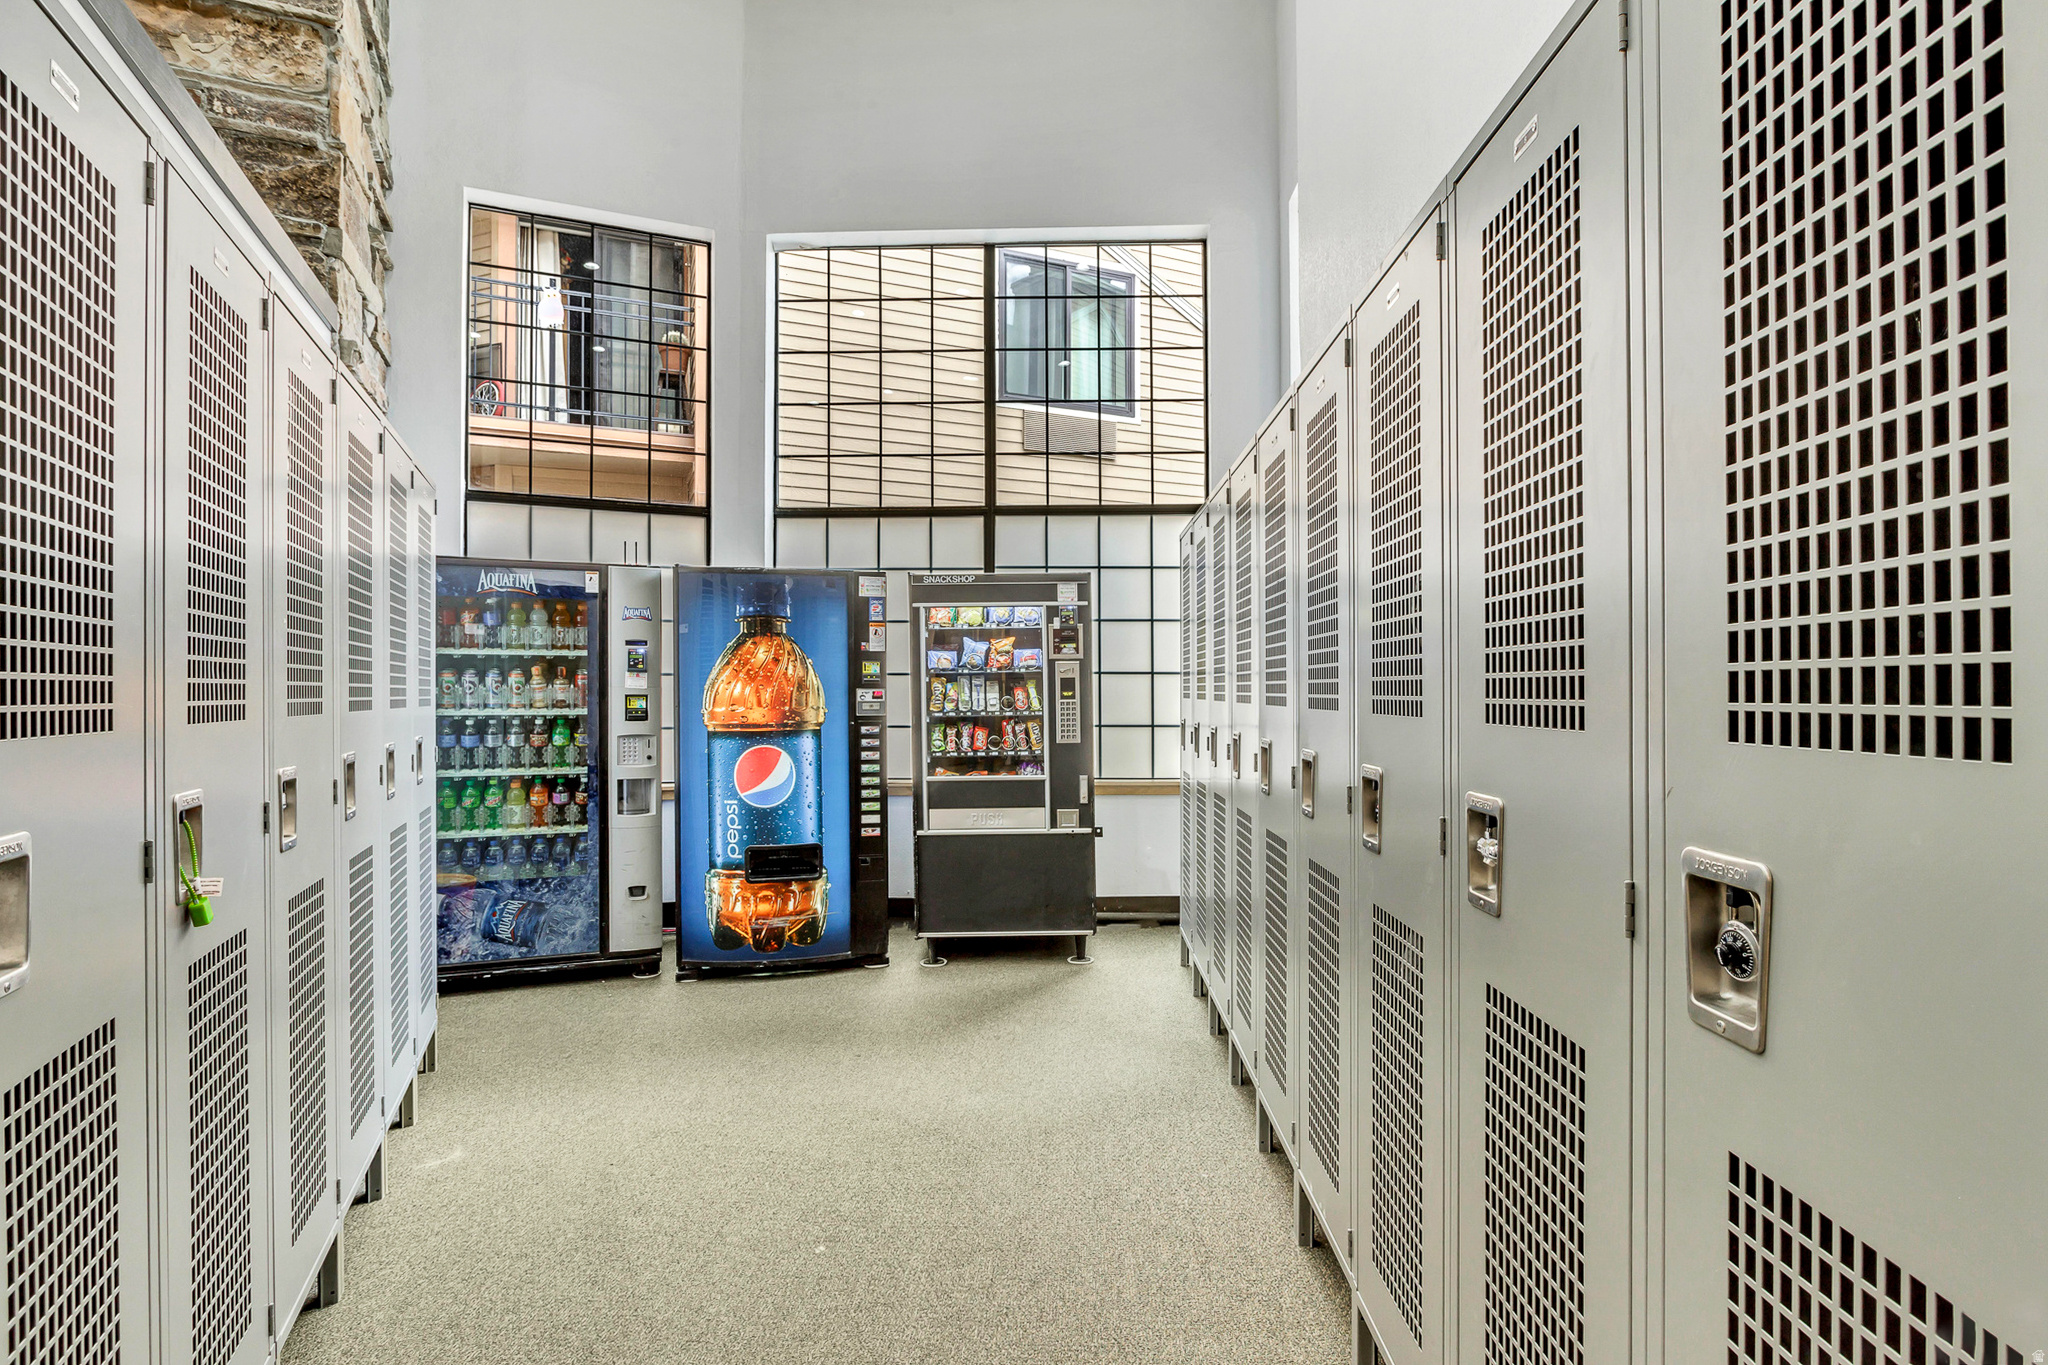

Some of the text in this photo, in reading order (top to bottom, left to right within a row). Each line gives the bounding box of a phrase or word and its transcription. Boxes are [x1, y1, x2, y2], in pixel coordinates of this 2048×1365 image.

[476, 568, 539, 594] AQUAFINA
[922, 575, 976, 584] SNACKSHOP
[623, 607, 652, 619] AQUAFINA
[724, 800, 742, 858] pepsi
[971, 812, 1003, 826] PUSH
[1695, 857, 1748, 880] JORGENSON
[495, 900, 528, 943] AQUAFINA
